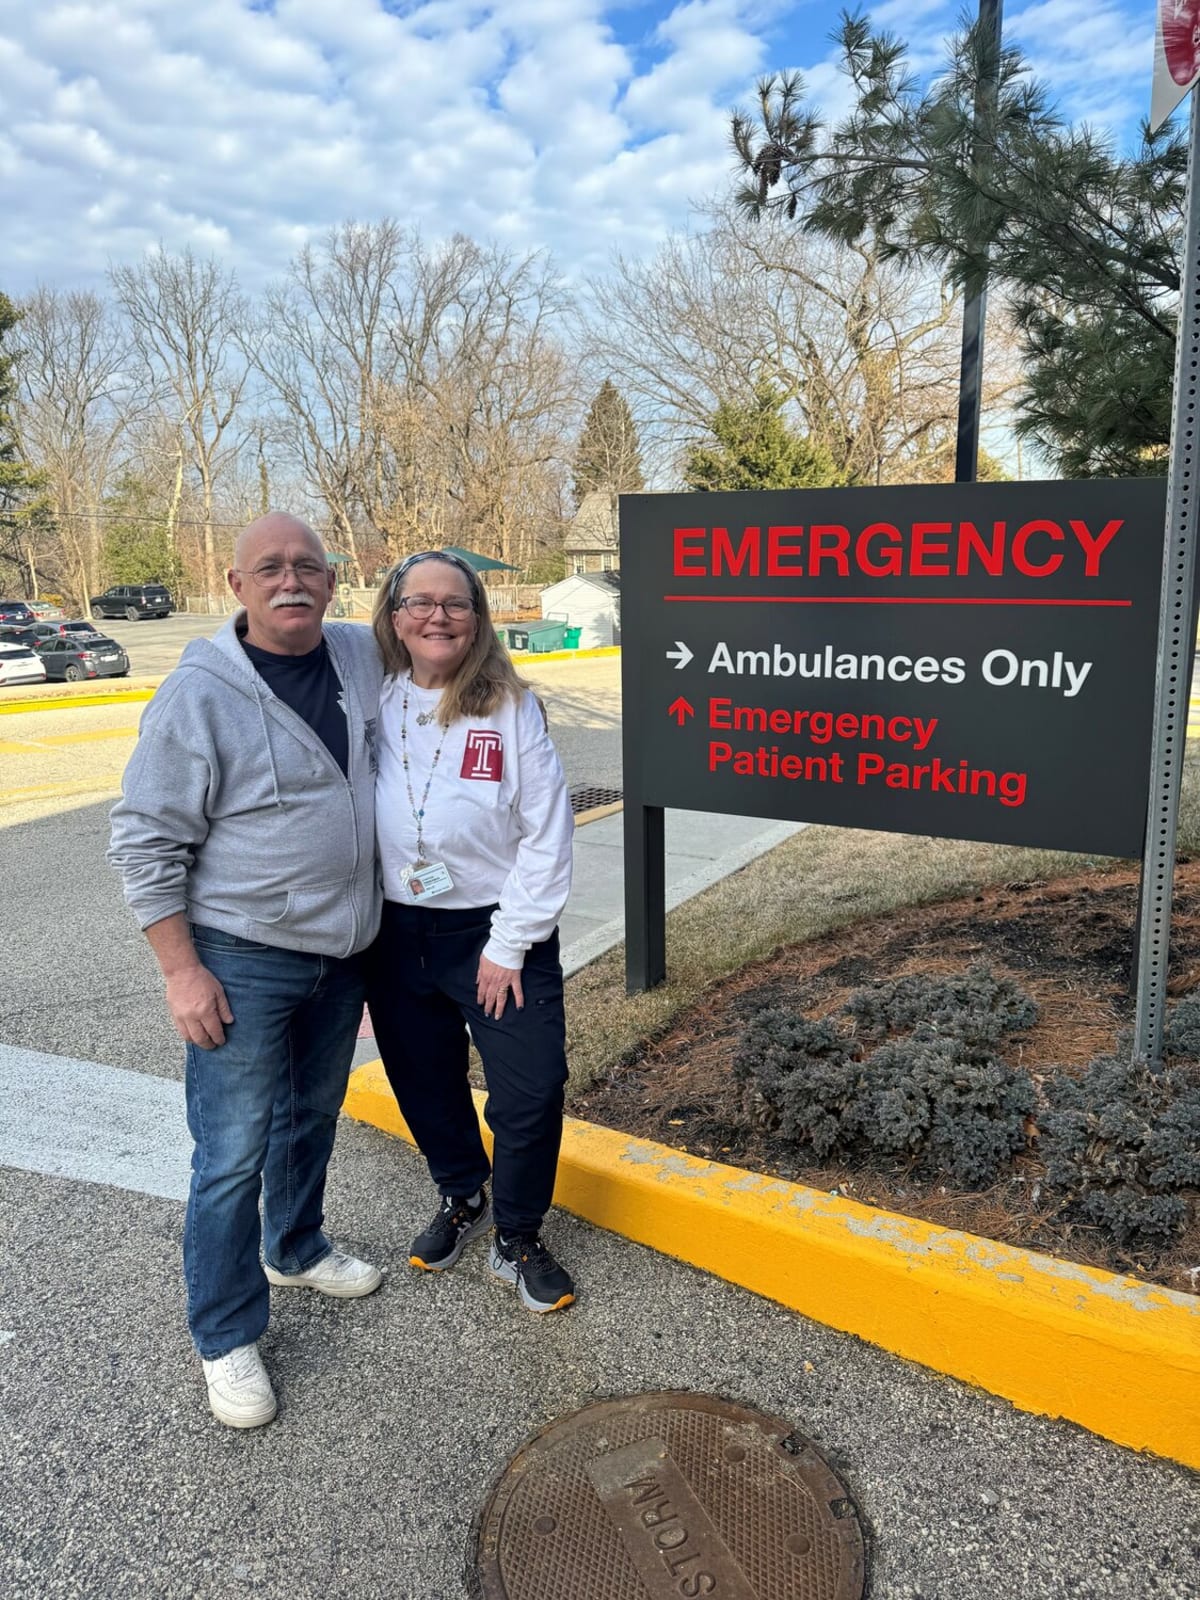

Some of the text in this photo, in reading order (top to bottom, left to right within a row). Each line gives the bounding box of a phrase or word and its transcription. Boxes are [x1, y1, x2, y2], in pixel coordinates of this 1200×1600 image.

[673, 519, 1124, 578] EMERGENCY
[707, 641, 1093, 697] Ambulances Only
[708, 697, 938, 751] Emergency
[708, 741, 1028, 808] Patient Parking
[624, 1475, 716, 1598] STORM
